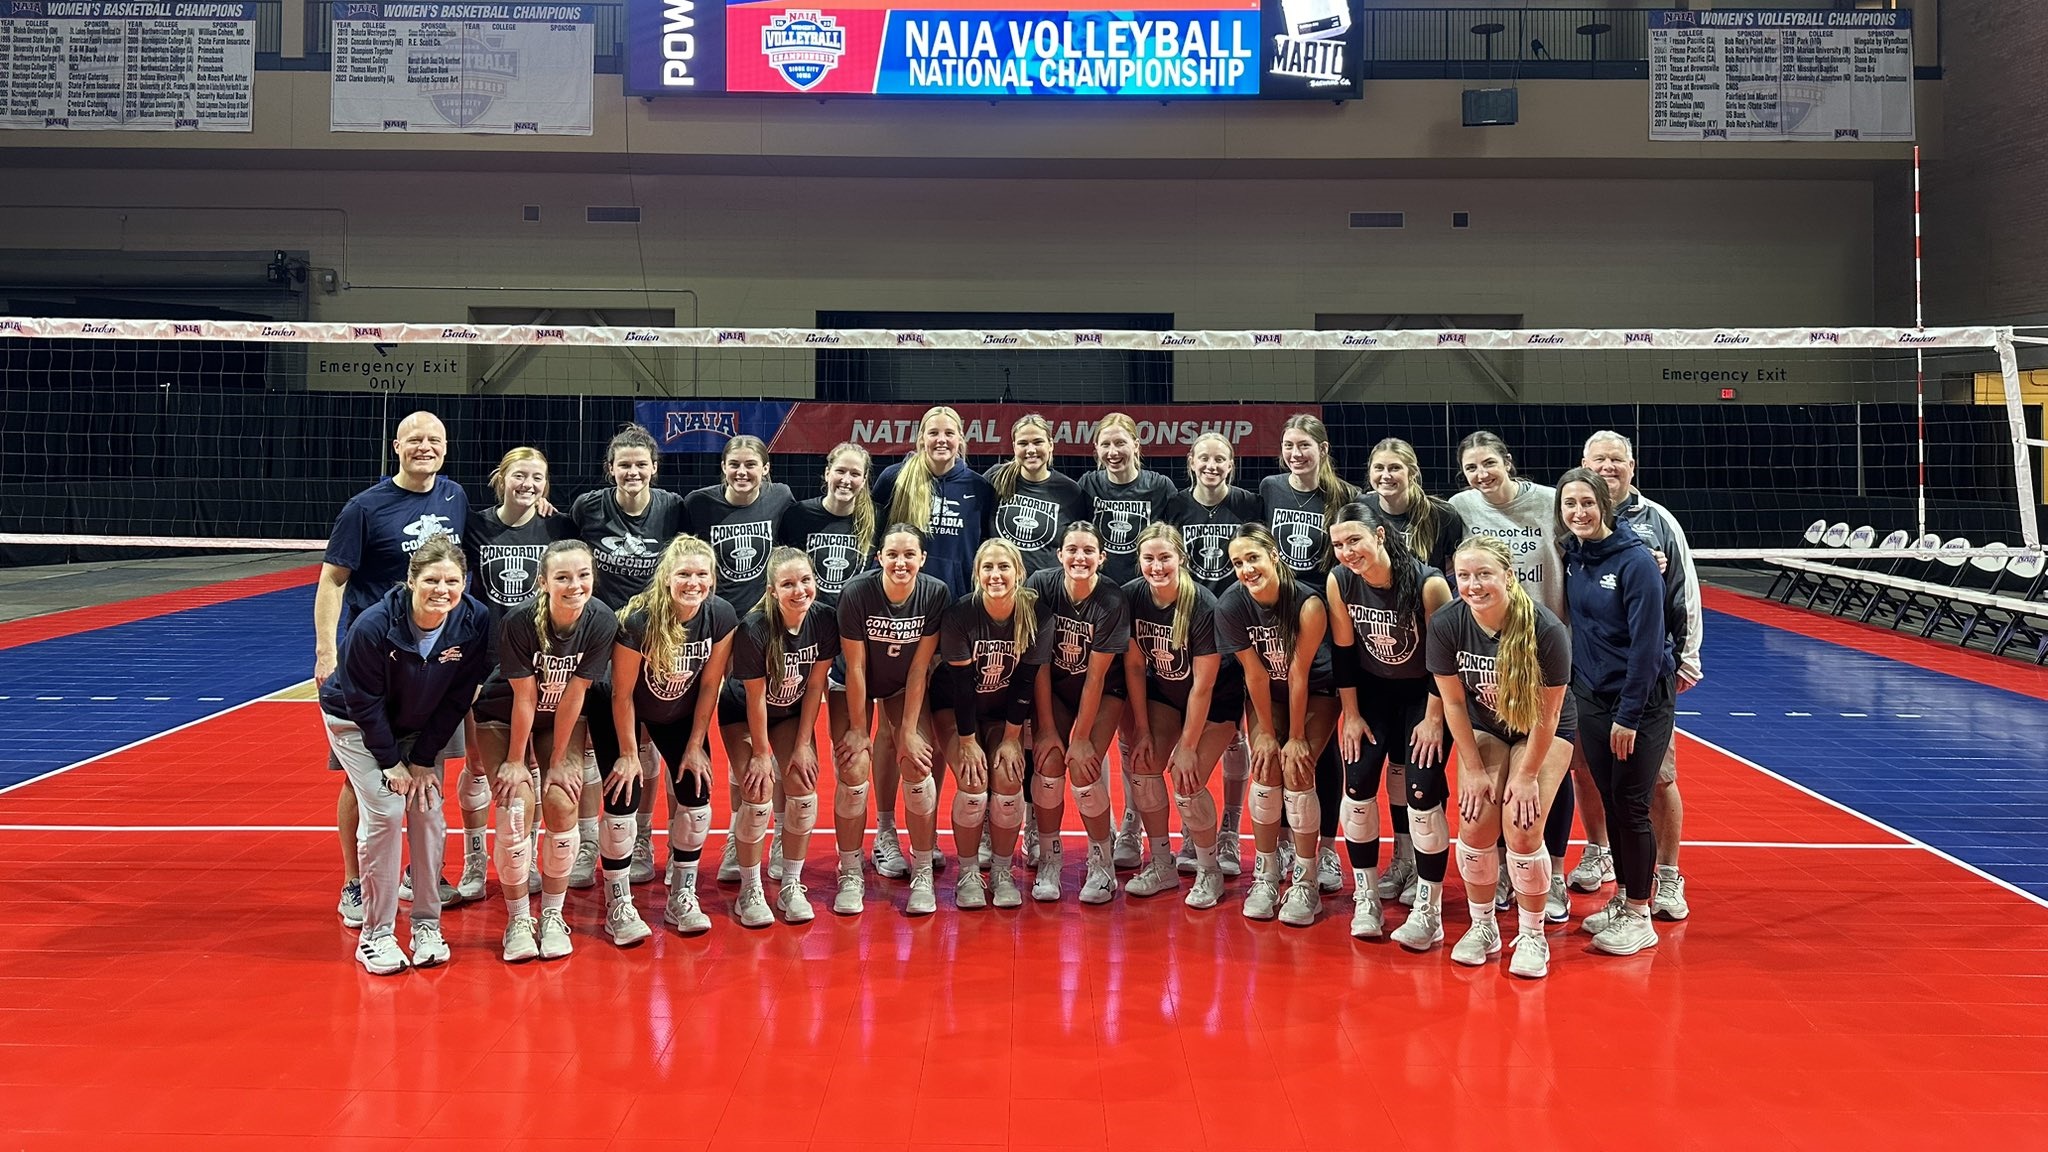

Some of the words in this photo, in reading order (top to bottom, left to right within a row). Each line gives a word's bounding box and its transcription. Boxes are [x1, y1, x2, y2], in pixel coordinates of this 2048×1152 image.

[12, 1, 42, 14] NAIA
[48, 3, 100, 17] WOMEN'S
[103, 3, 171, 17] BASKETBALL
[175, 4, 243, 17] CHAMPIONS
[348, 4, 378, 17] NAIA
[384, 4, 438, 18] WOMEN'S
[440, 5, 509, 19] BASKETBALL
[513, 6, 582, 21] CHAMPIONS
[1664, 11, 1696, 25] NAIA
[1700, 12, 1754, 26] WOMEN'S
[1757, 13, 1825, 26] VOLLEYBALL
[1828, 13, 1897, 26] CHAMPIONS
[767, 31, 841, 48] VOLLEYBALL
[905, 20, 998, 58] NAIA
[1008, 20, 1251, 59] VOLLEYBALL
[909, 58, 1033, 87] NATIONAL
[1039, 58, 1244, 87] CHAMPIONSHIP
[81, 323, 115, 334] Baden
[174, 324, 201, 335] NAIA
[262, 326, 296, 337] Baden
[354, 327, 382, 340] NAIA
[442, 329, 477, 339] Baden
[536, 329, 565, 341] NAIA
[624, 332, 659, 342] Baden
[718, 331, 746, 343] NAIA
[805, 333, 840, 343] Baden
[897, 333, 924, 345] NAIA
[983, 334, 1017, 344] Baden
[1074, 333, 1102, 344] NAIA
[1161, 335, 1196, 345] Baden
[1254, 334, 1282, 345] NAIA
[1342, 335, 1377, 345] Baden
[1437, 333, 1466, 345] NAIA
[1527, 334, 1563, 344] Baden
[1624, 332, 1653, 344] NAIA
[1714, 333, 1750, 344] Baden
[1809, 332, 1839, 344] NAIA
[1899, 333, 1936, 343] Baden
[320, 360, 414, 376] Emergency
[424, 359, 457, 373] Exit
[1662, 368, 1749, 383] Emergency
[1758, 368, 1787, 381] Exit
[370, 376, 406, 392] Only
[665, 411, 739, 441] NAIA
[851, 419, 1001, 443] NATIAL
[1046, 420, 1253, 445] HAMONSHIP
[1095, 499, 1148, 518] CONCORDIA
[1274, 511, 1324, 532] CONCORDI
[712, 524, 770, 545] CONCORDIA
[1471, 526, 1543, 538] Concordia
[1137, 622, 1174, 641] CONCOR
[887, 645, 901, 658] C
[1458, 652, 1495, 671] CONCO
